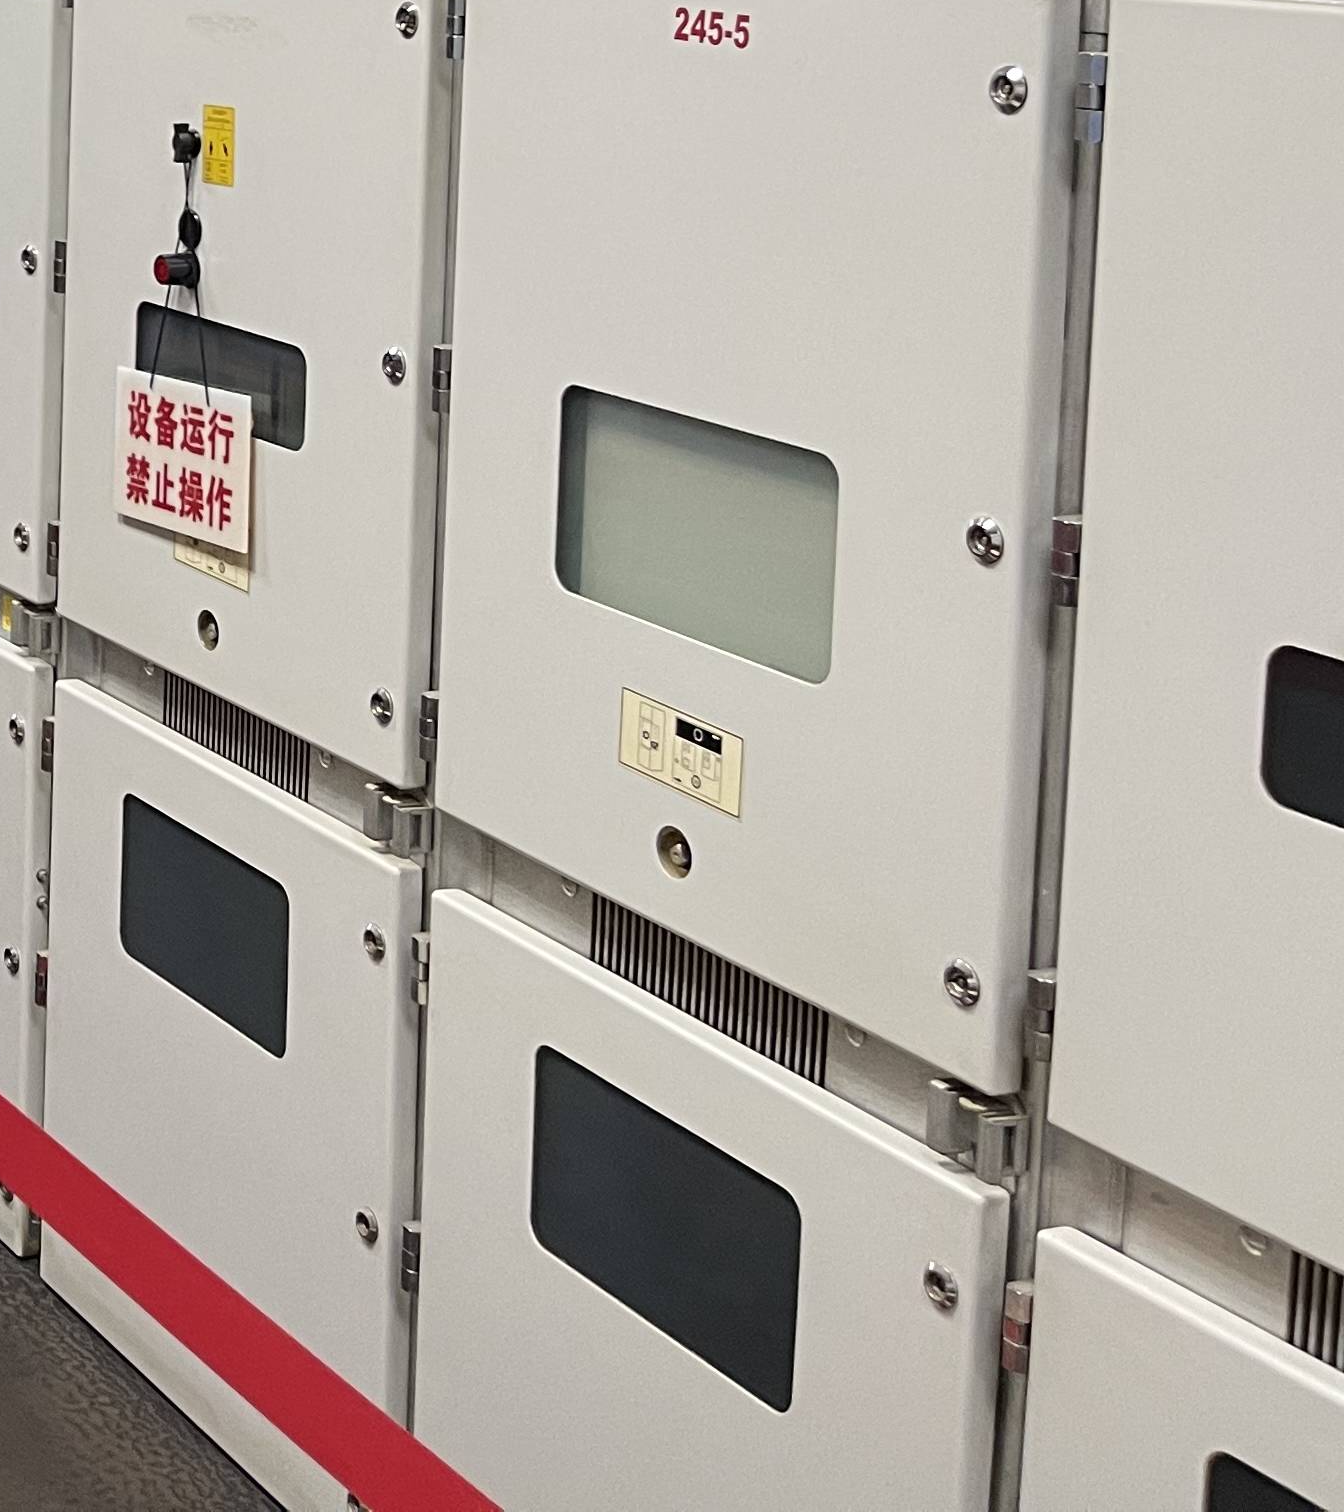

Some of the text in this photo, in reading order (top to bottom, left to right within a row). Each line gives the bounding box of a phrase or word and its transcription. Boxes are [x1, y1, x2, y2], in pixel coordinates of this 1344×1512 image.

[674, 7, 751, 50] 245-5
[127, 391, 235, 465] 设备运行
[125, 452, 233, 530] 禁止操作
